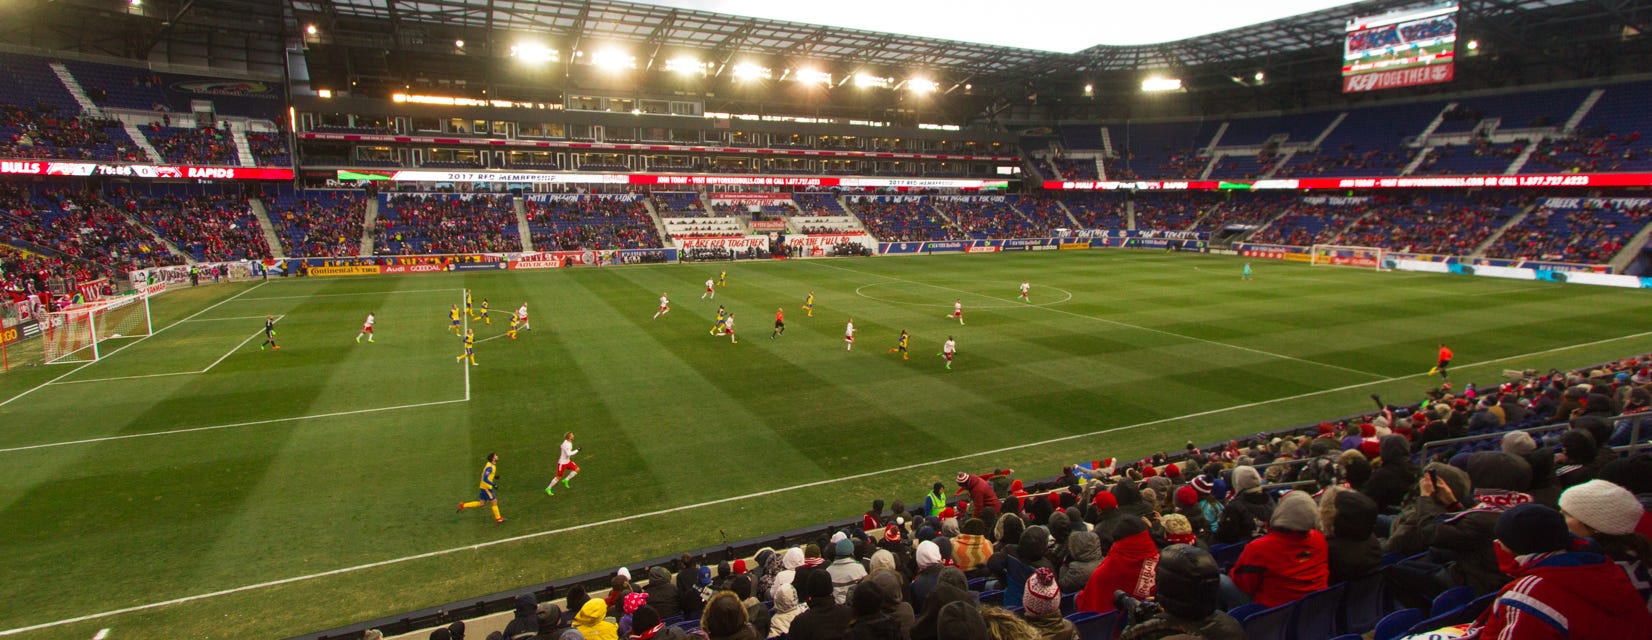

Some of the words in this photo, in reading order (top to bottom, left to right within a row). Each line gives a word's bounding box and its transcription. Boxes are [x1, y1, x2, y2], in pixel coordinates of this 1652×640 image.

[1, 161, 41, 174] BULLS
[188, 167, 235, 178] RAPIDS
[670, 176, 688, 184] TODAY
[1485, 176, 1498, 186] OR
[1498, 176, 1518, 186] CALL
[728, 238, 765, 248] TOGETHER
[310, 267, 353, 276] Continental
